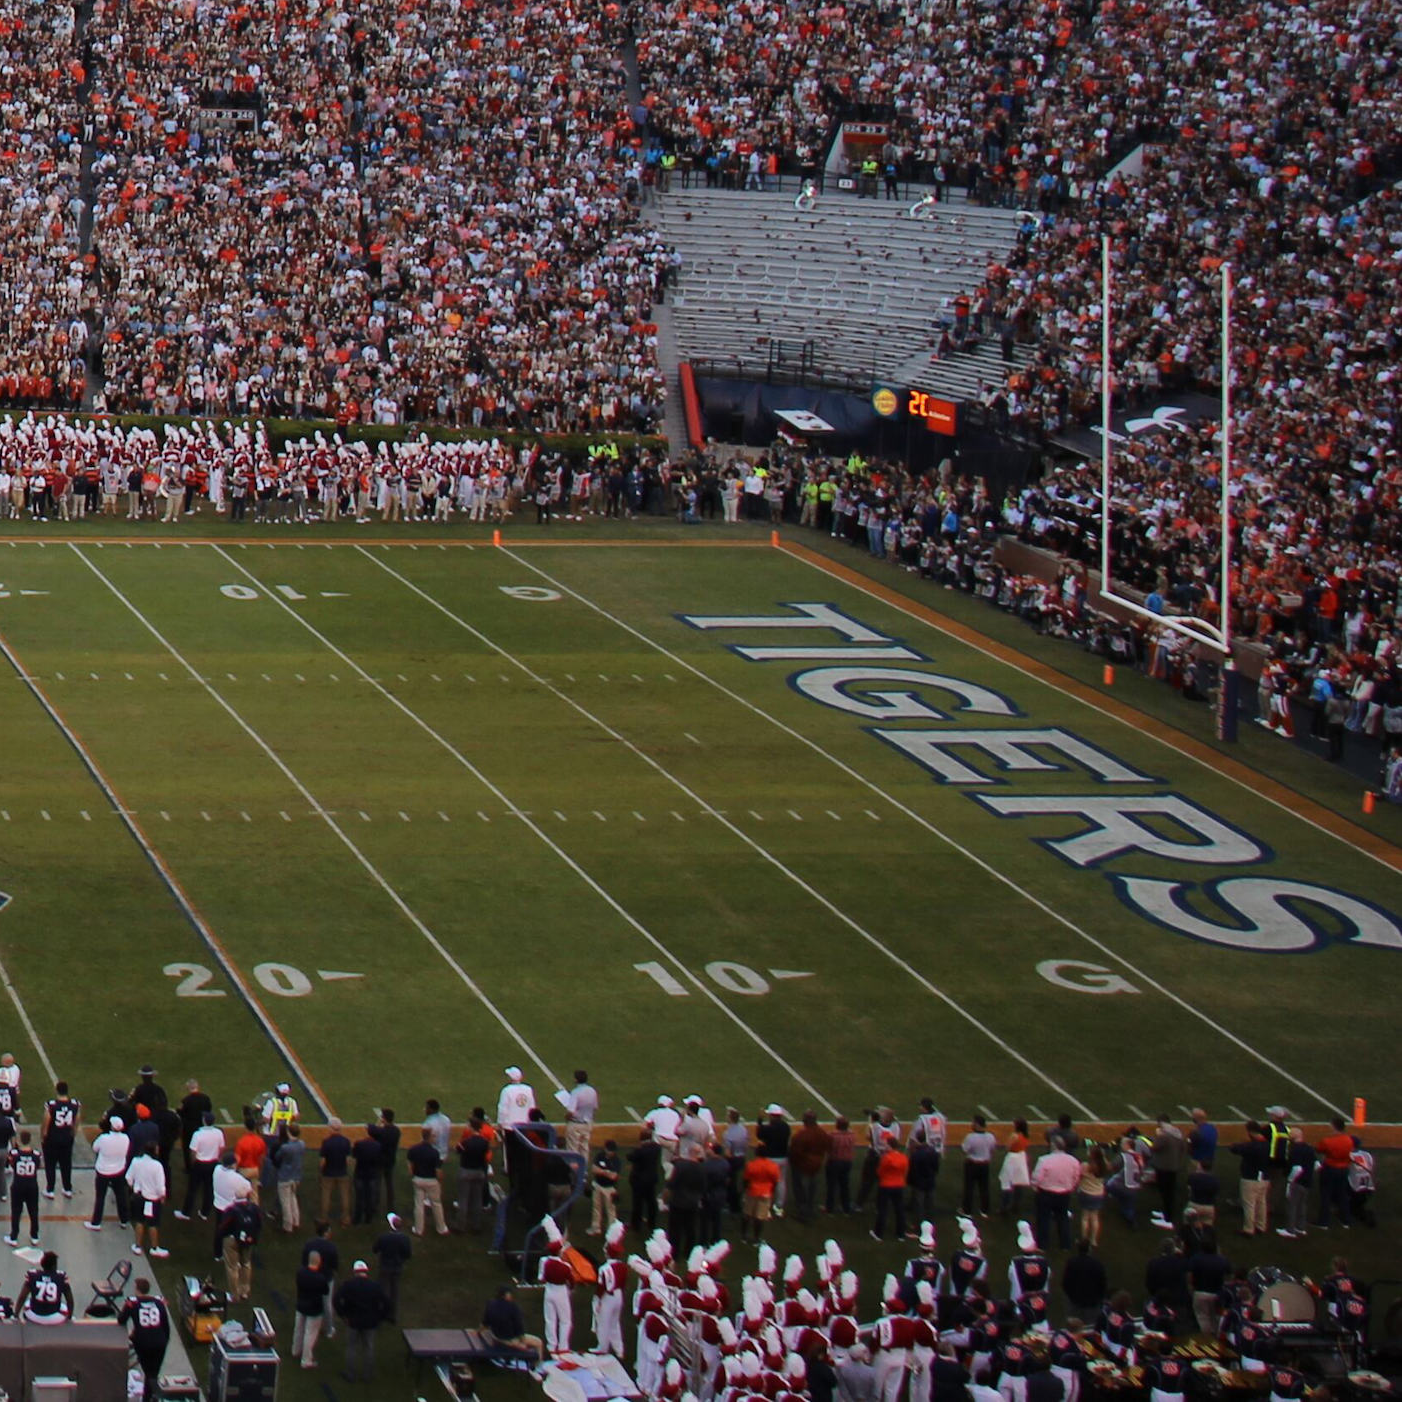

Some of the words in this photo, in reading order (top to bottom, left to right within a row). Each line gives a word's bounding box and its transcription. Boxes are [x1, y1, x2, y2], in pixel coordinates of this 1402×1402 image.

[499, 585, 562, 601] G
[676, 601, 1402, 953] TIGERS
[162, 961, 312, 998] 20
[633, 961, 771, 996] 10
[1036, 959, 1141, 995] G
[54, 1109, 74, 1128] 54
[15, 1160, 36, 1177] 60
[36, 1282, 58, 1302] 79
[139, 1307, 161, 1327] 68
